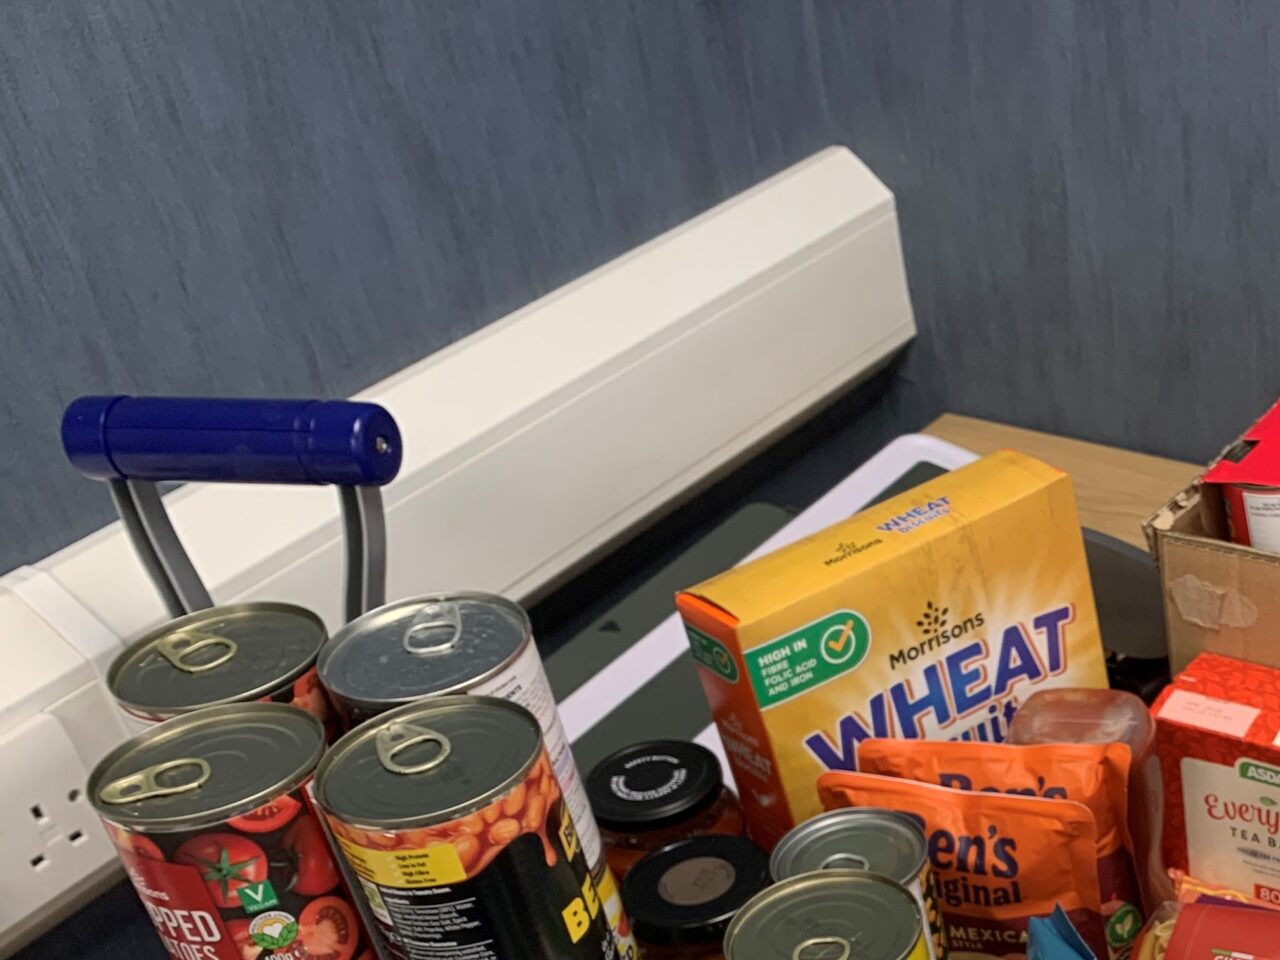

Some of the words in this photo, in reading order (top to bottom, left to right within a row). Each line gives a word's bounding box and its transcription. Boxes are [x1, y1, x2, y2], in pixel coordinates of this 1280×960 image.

[876, 496, 951, 532] WHEAT
[824, 538, 883, 566] Morrisons
[758, 646, 791, 666] HIGH
[793, 638, 808, 652] IN
[888, 611, 986, 670] Morrisons
[762, 661, 789, 677] FIBRE
[765, 670, 793, 687] FOLIC
[795, 659, 817, 673] ACID
[768, 681, 789, 696] AND
[791, 672, 813, 687] IRON
[803, 605, 1071, 773] WHEAT
[1230, 826, 1261, 844] TEA
[935, 873, 1021, 908] iginal
[148, 903, 221, 942] PPED
[949, 926, 1029, 946] MEXICA
